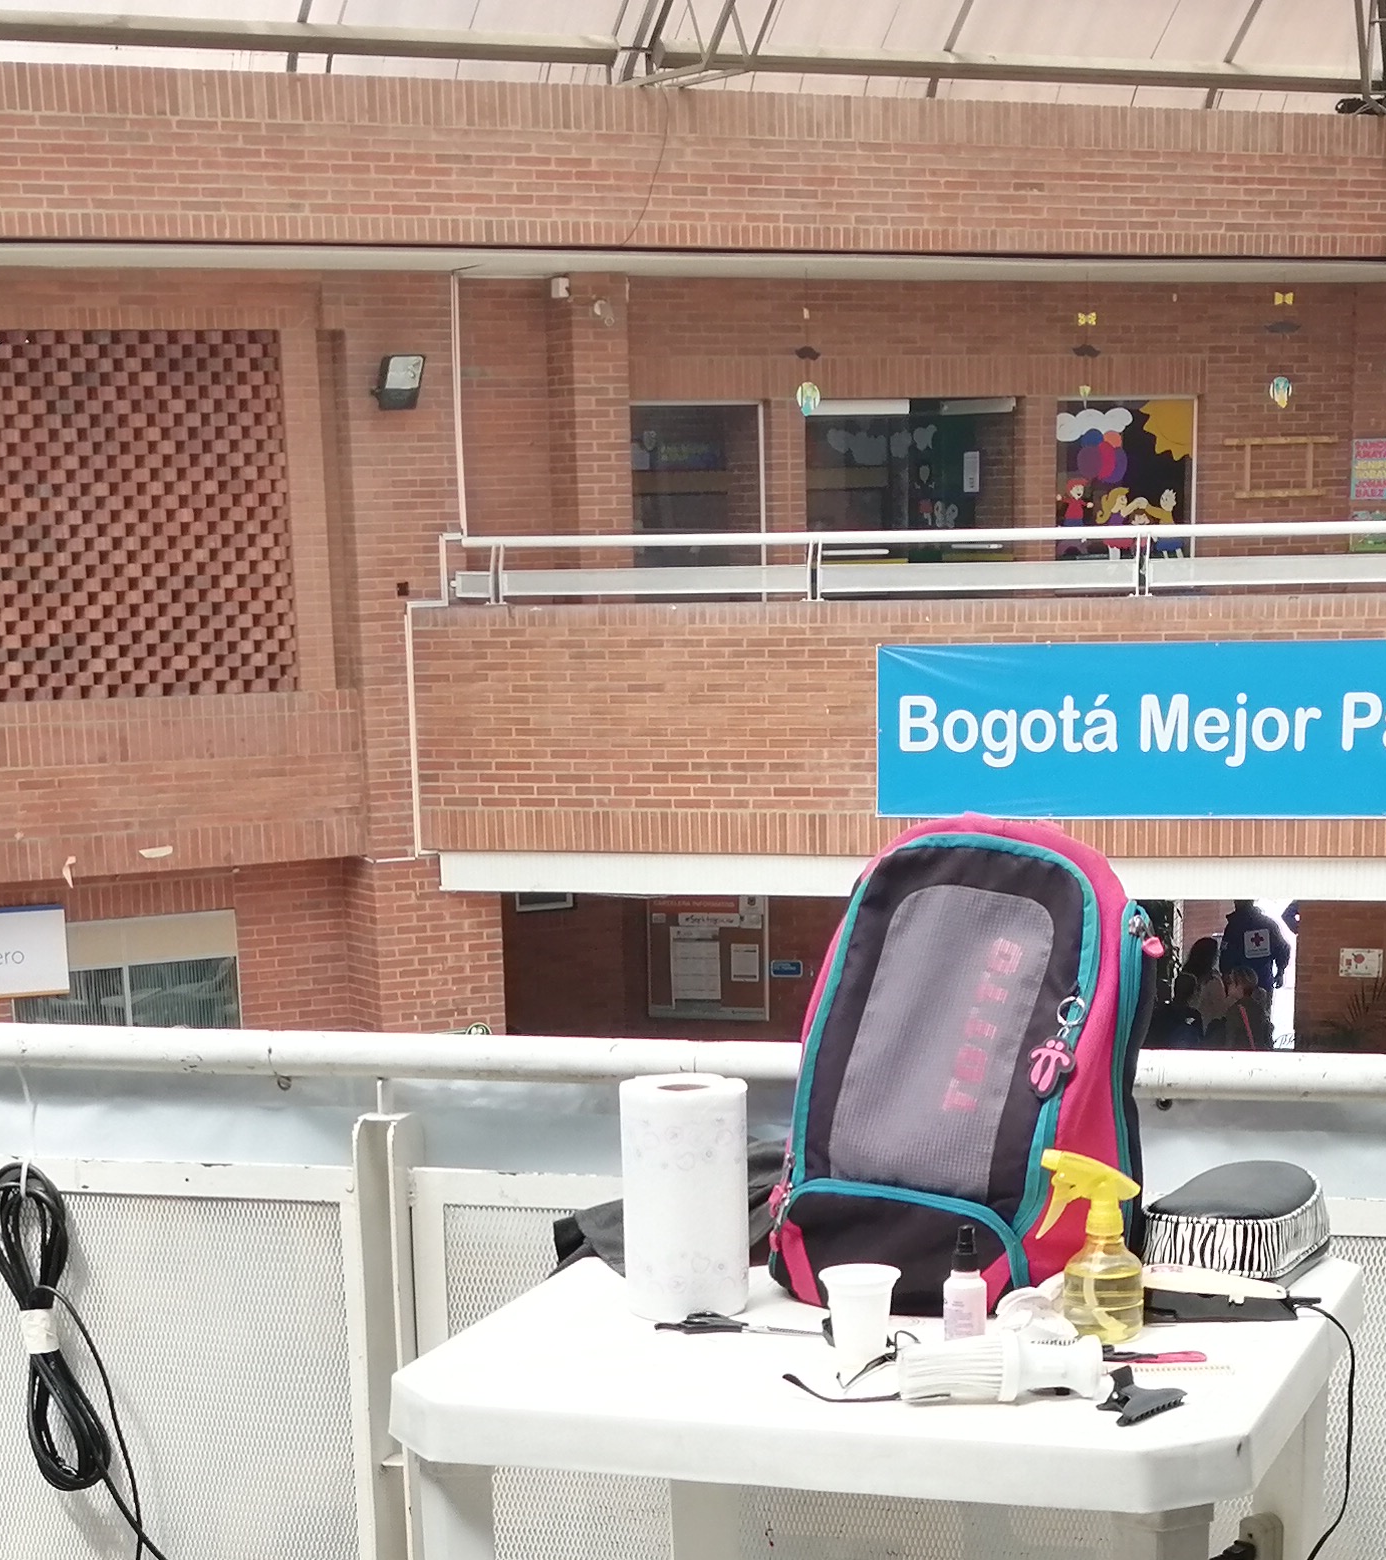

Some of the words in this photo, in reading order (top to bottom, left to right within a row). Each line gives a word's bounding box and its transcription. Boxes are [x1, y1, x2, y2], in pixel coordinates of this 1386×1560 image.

[897, 693, 1118, 767] Bogotá
[1140, 692, 1322, 768] Mejor
[941, 937, 1024, 1113] TOTTO
